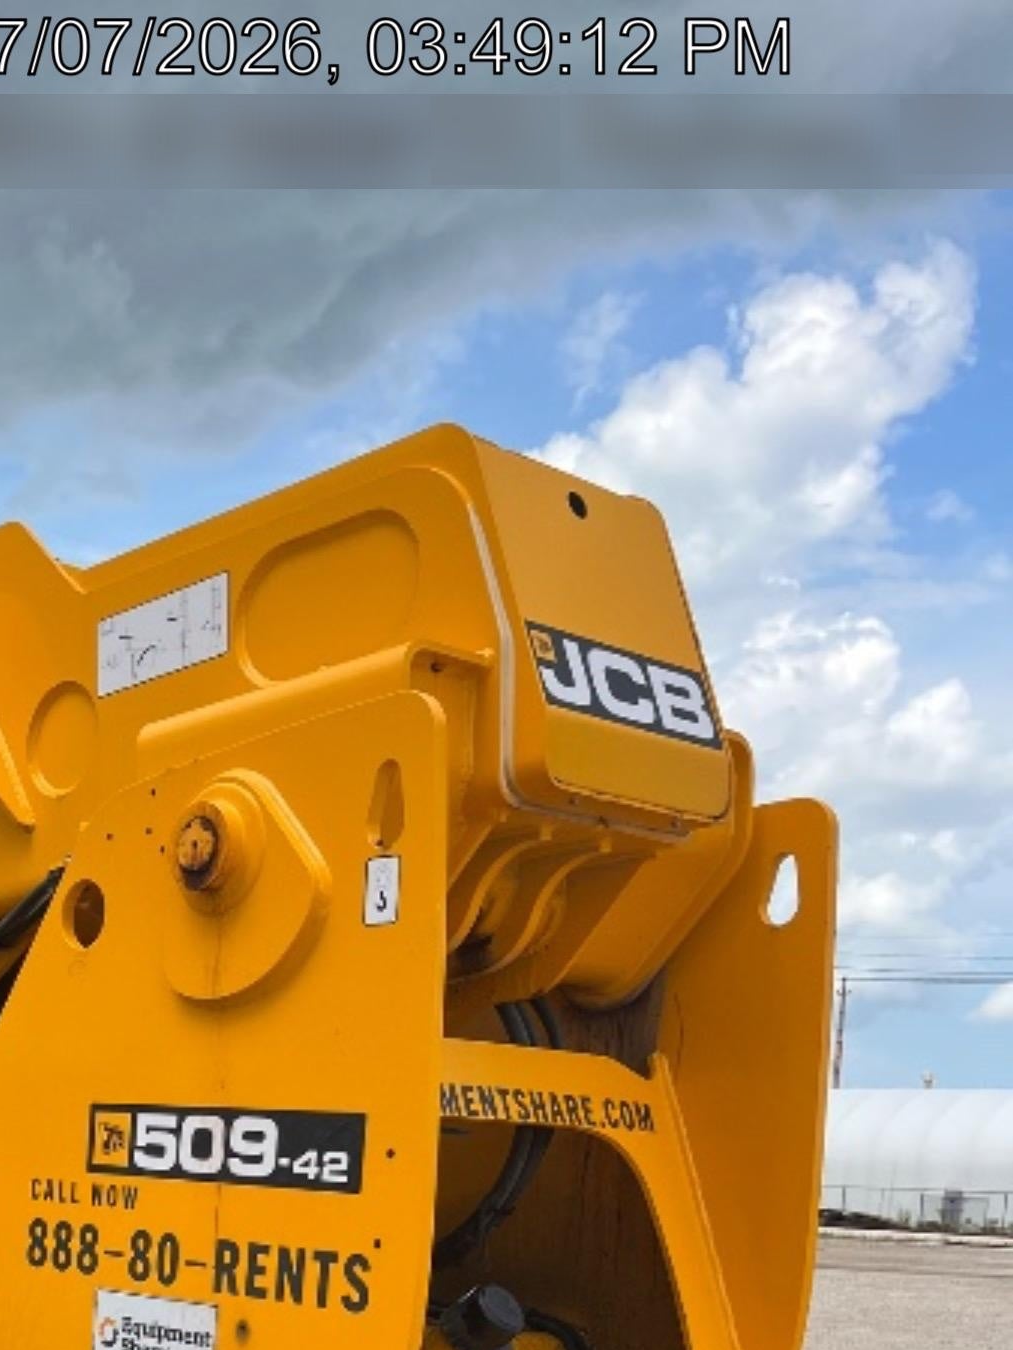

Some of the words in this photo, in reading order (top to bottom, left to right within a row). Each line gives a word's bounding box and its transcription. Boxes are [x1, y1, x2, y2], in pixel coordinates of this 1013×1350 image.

[539, 638, 715, 740] JCB
[439, 1081, 655, 1132] MENTSHARE.COM
[132, 1112, 350, 1183] 509-42
[30, 1178, 81, 1204] CALL
[91, 1184, 139, 1210] NOW
[26, 1217, 371, 1313] 888-80-RENTS
[120, 1316, 213, 1348] Equipment
